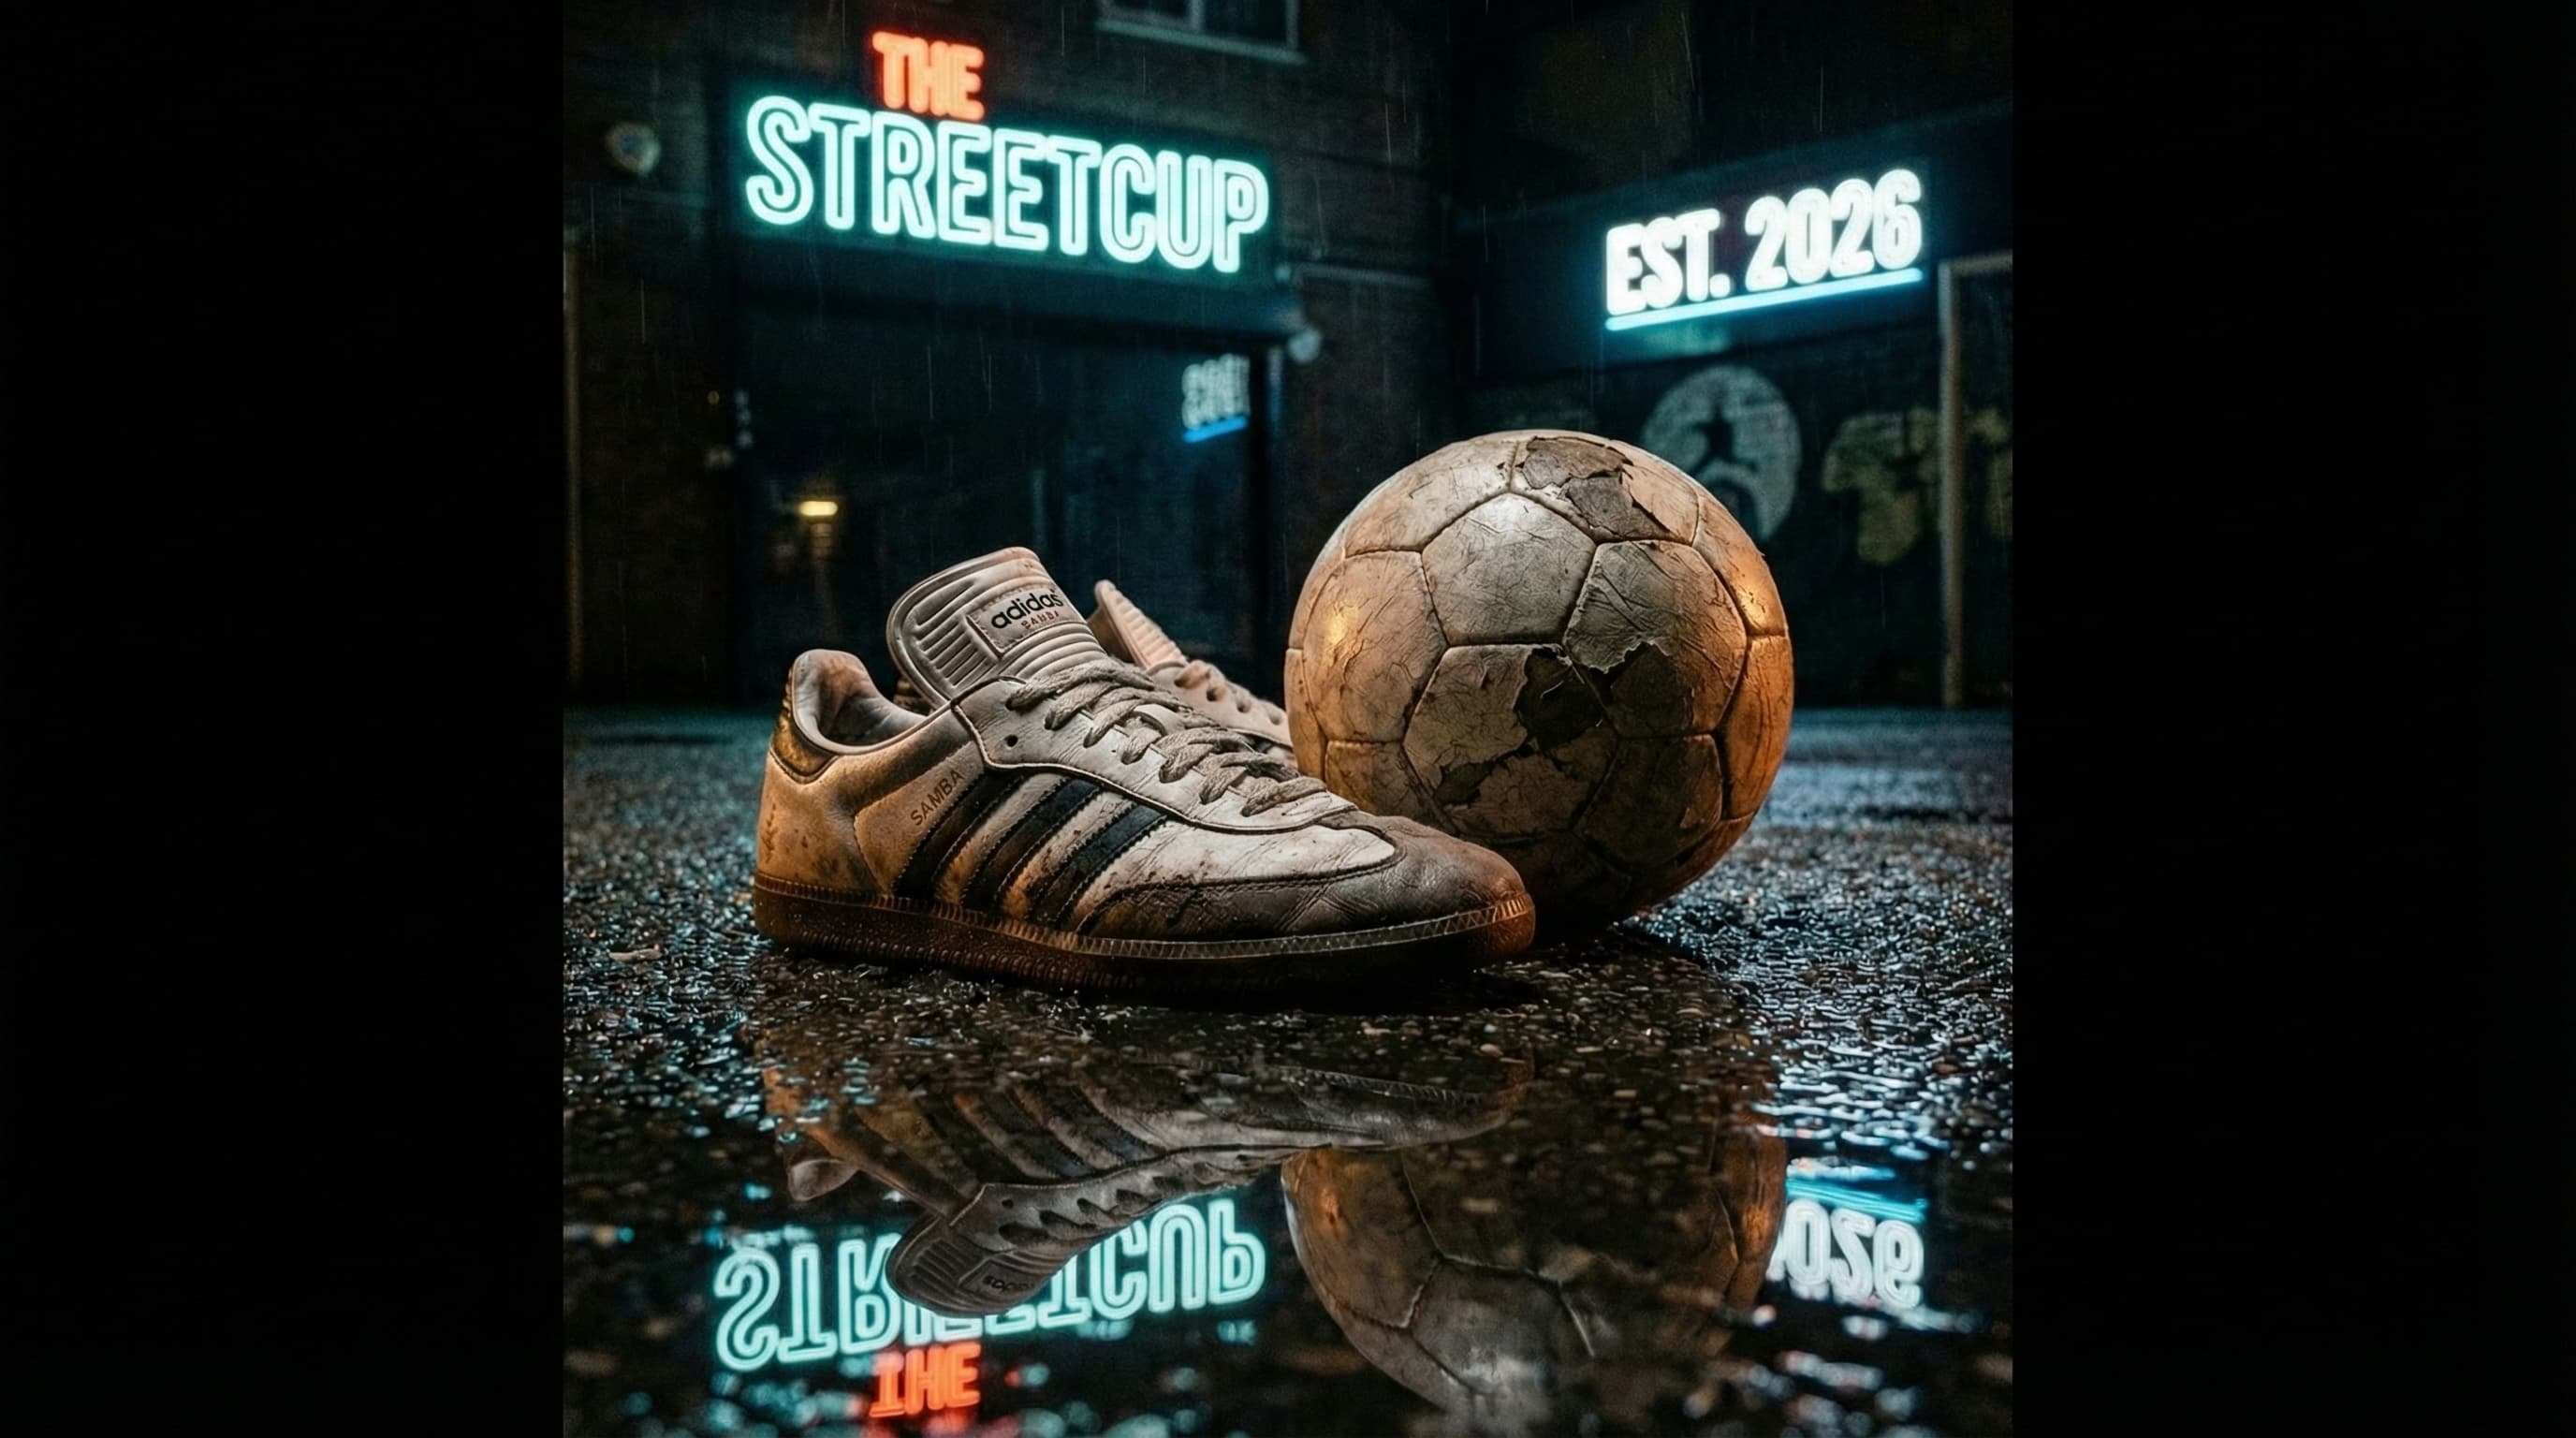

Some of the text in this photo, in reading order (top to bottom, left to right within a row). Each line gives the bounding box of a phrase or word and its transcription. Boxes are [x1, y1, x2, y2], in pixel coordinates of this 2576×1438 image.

[871, 31, 984, 122] THE
[746, 95, 1269, 273] STREETCUP
[1606, 169, 1922, 315] EST. 2026
[991, 592, 1063, 628] adidas
[910, 770, 964, 826] SAMBA
